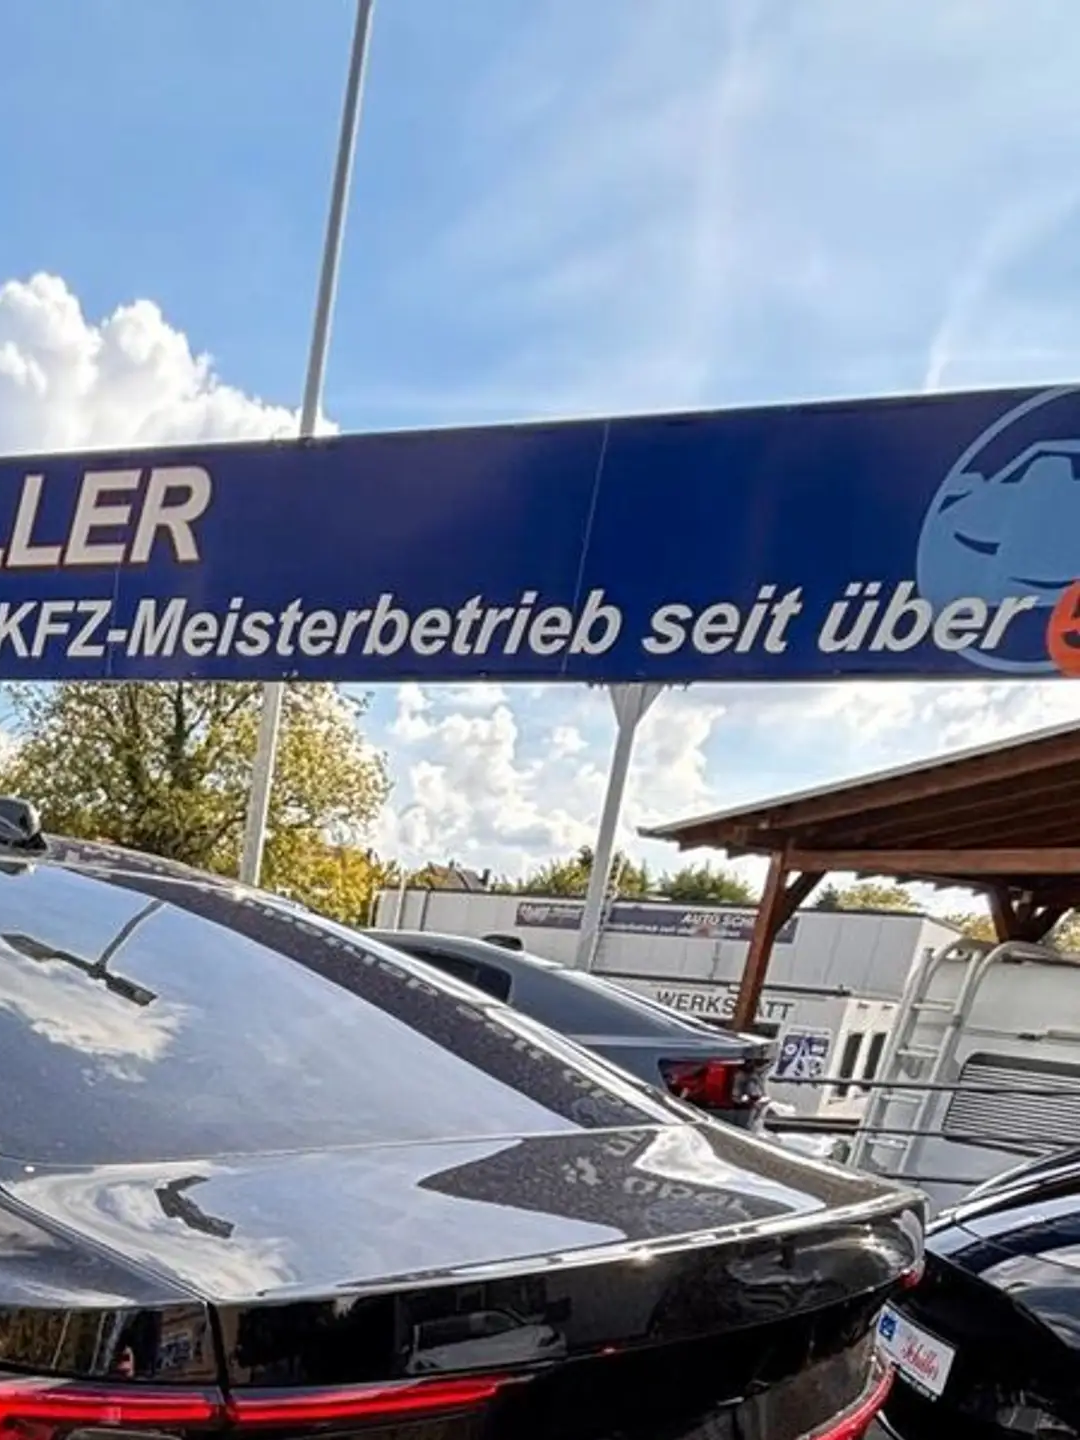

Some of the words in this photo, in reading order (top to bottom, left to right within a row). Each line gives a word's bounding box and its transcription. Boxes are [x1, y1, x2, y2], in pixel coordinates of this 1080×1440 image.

[641, 584, 803, 654] seit
[818, 580, 1041, 653] über
[657, 990, 794, 1020] WERKSTT
